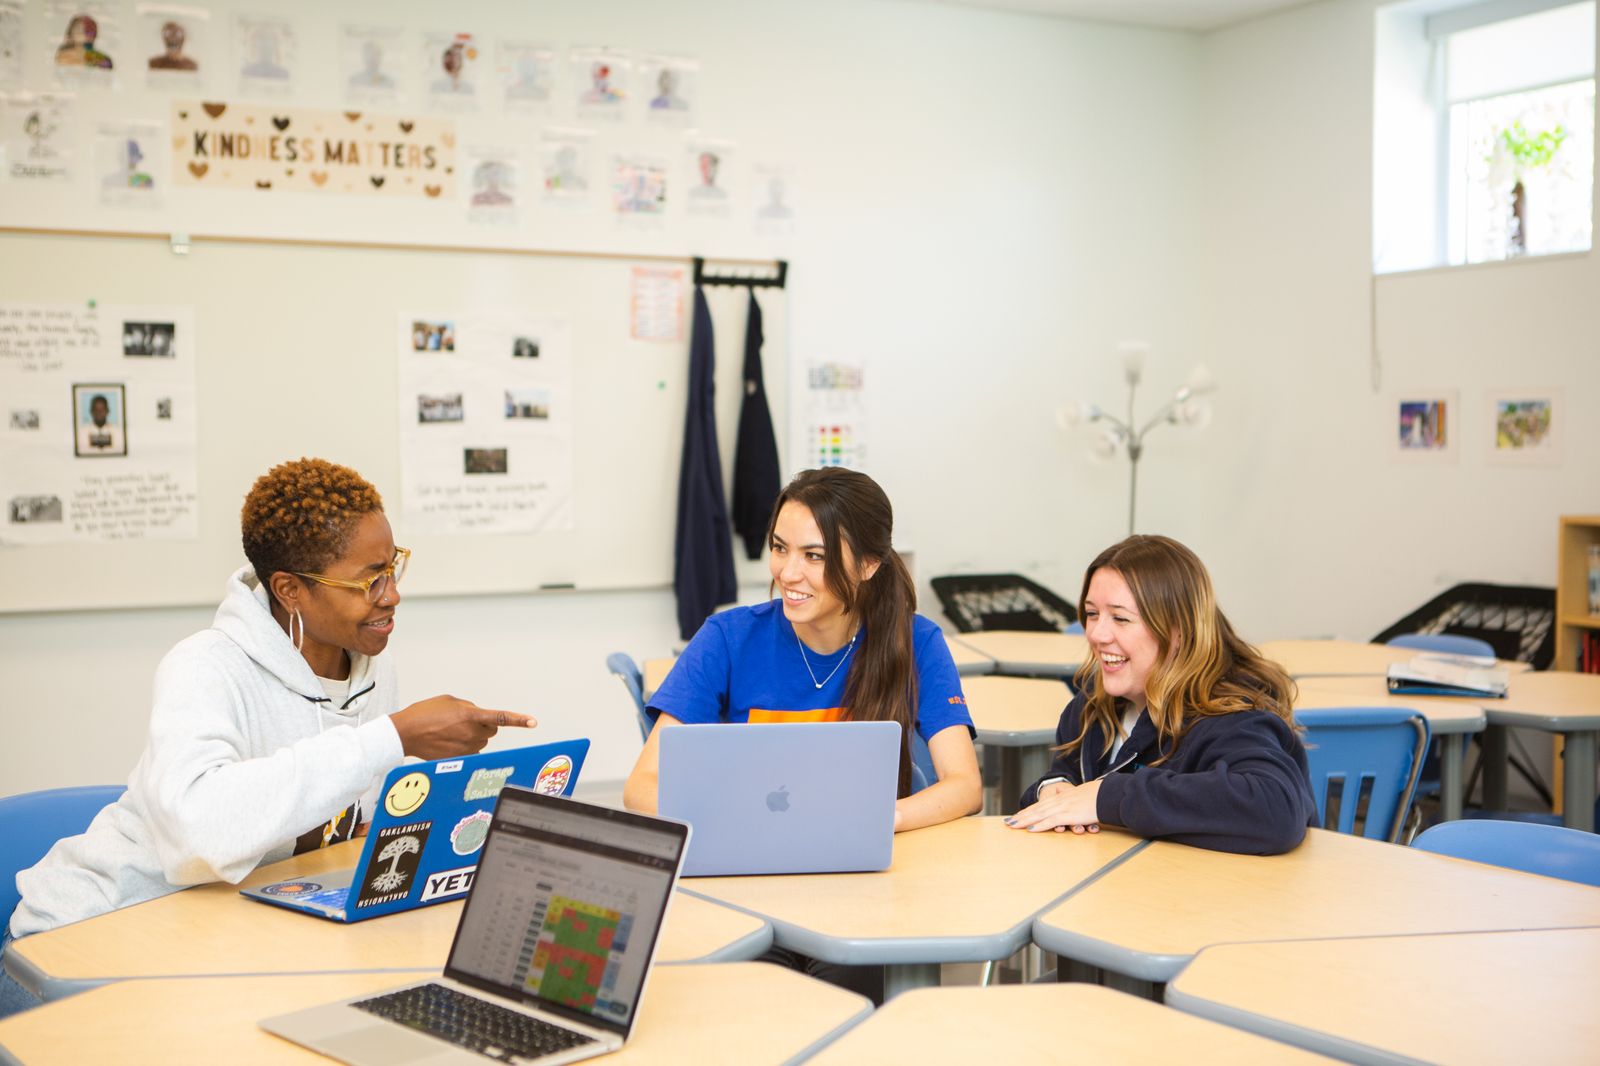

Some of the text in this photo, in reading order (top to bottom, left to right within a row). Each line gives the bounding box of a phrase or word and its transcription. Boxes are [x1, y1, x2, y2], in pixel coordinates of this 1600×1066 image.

[194, 131, 437, 170] KINDNESS MATTERS
[380, 822, 432, 837] OAKLANDISH
[358, 891, 408, 908] OAKLANDISH
